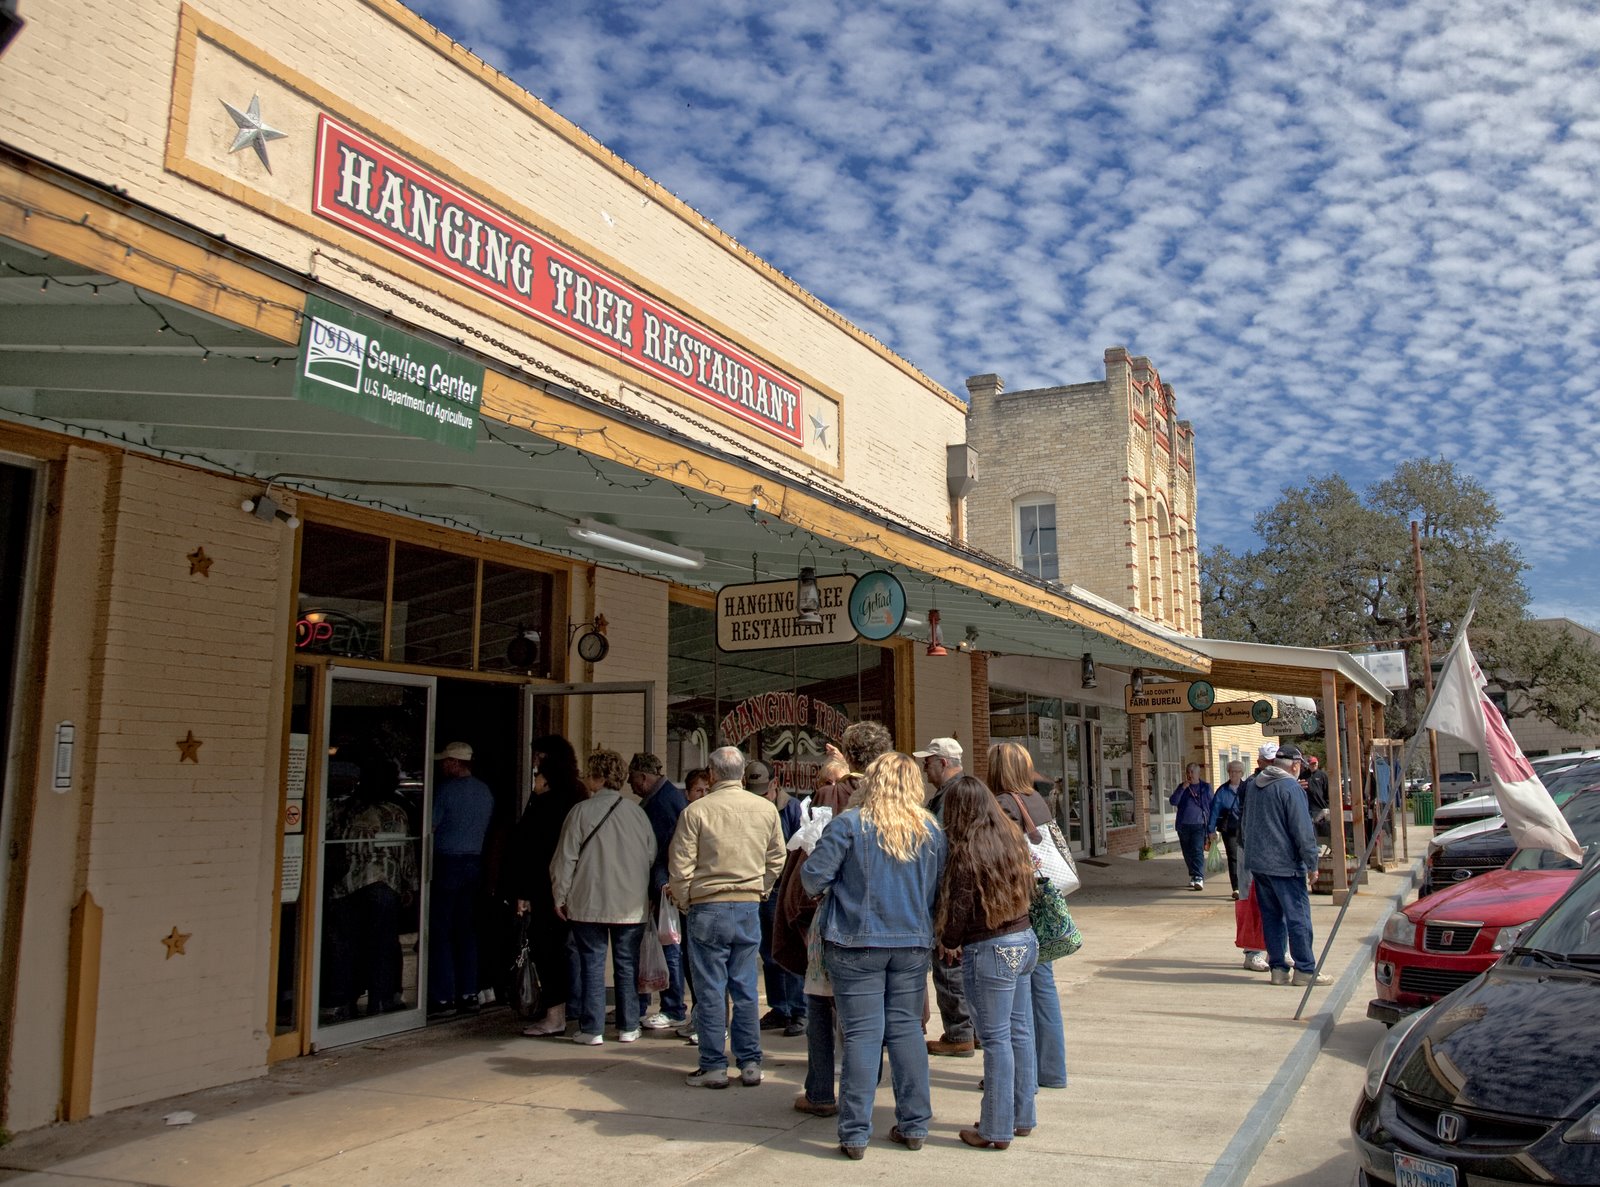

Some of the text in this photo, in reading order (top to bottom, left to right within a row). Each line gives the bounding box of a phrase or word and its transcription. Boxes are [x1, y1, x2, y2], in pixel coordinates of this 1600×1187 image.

[336, 142, 797, 429] HANGING TREE RESTAURANT
[314, 322, 362, 359] USDA
[367, 339, 478, 404] Service Center
[364, 377, 473, 429] U.S. Department of Agriculture
[724, 590, 795, 617] HANGING
[857, 588, 892, 627] Goliad
[1130, 696, 1182, 707] FARM BUREAU
[1154, 687, 1176, 695] COUNTY
[720, 691, 852, 747] HANGING TRE
[1410, 1160, 1437, 1176] TEXAS
